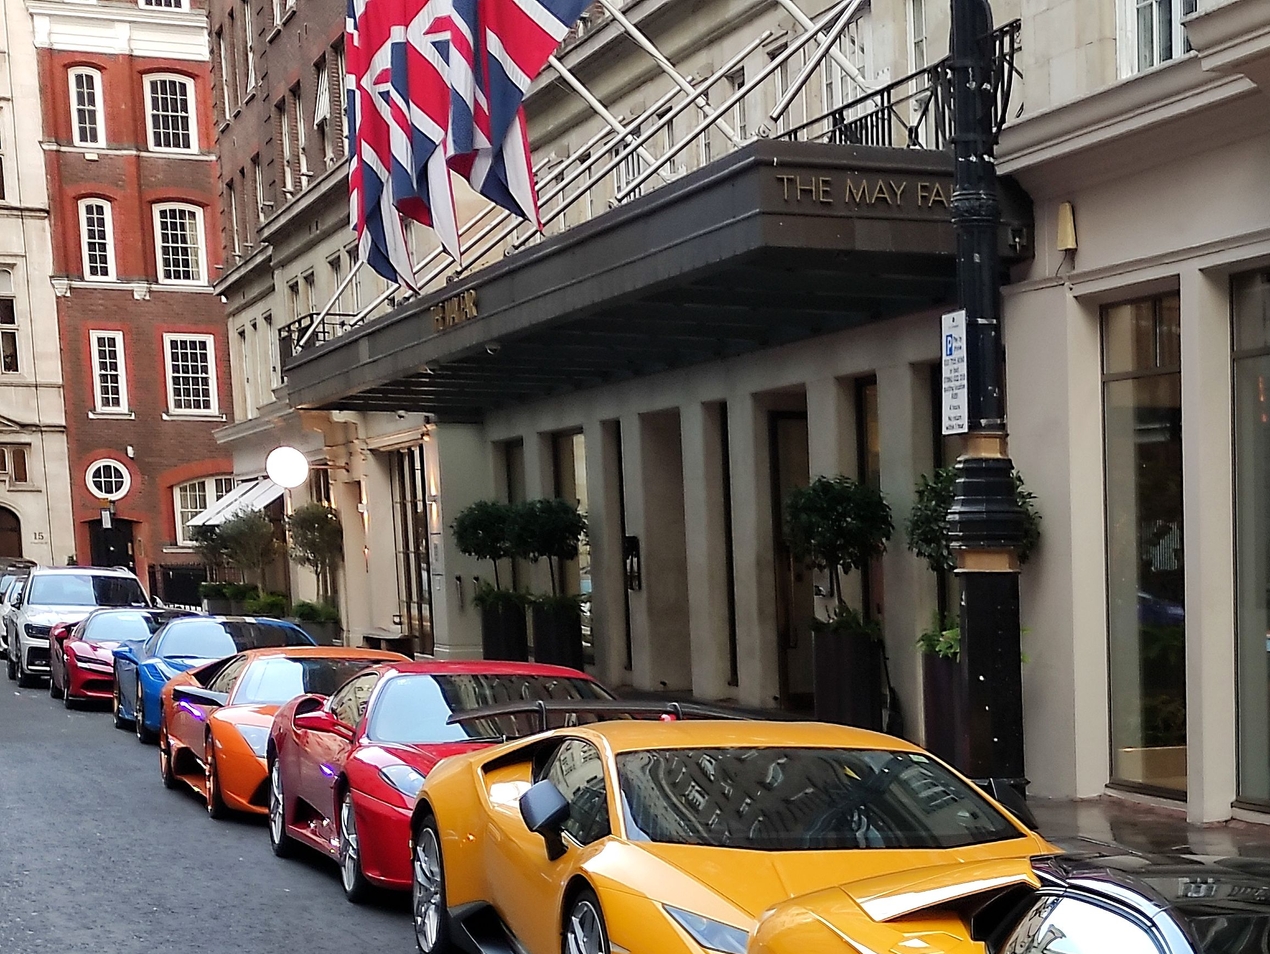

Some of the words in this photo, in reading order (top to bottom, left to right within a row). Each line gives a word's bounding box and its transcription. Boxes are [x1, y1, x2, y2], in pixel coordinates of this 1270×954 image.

[776, 175, 833, 202] THE
[845, 178, 906, 205] MAY
[33, 532, 44, 540] 15
